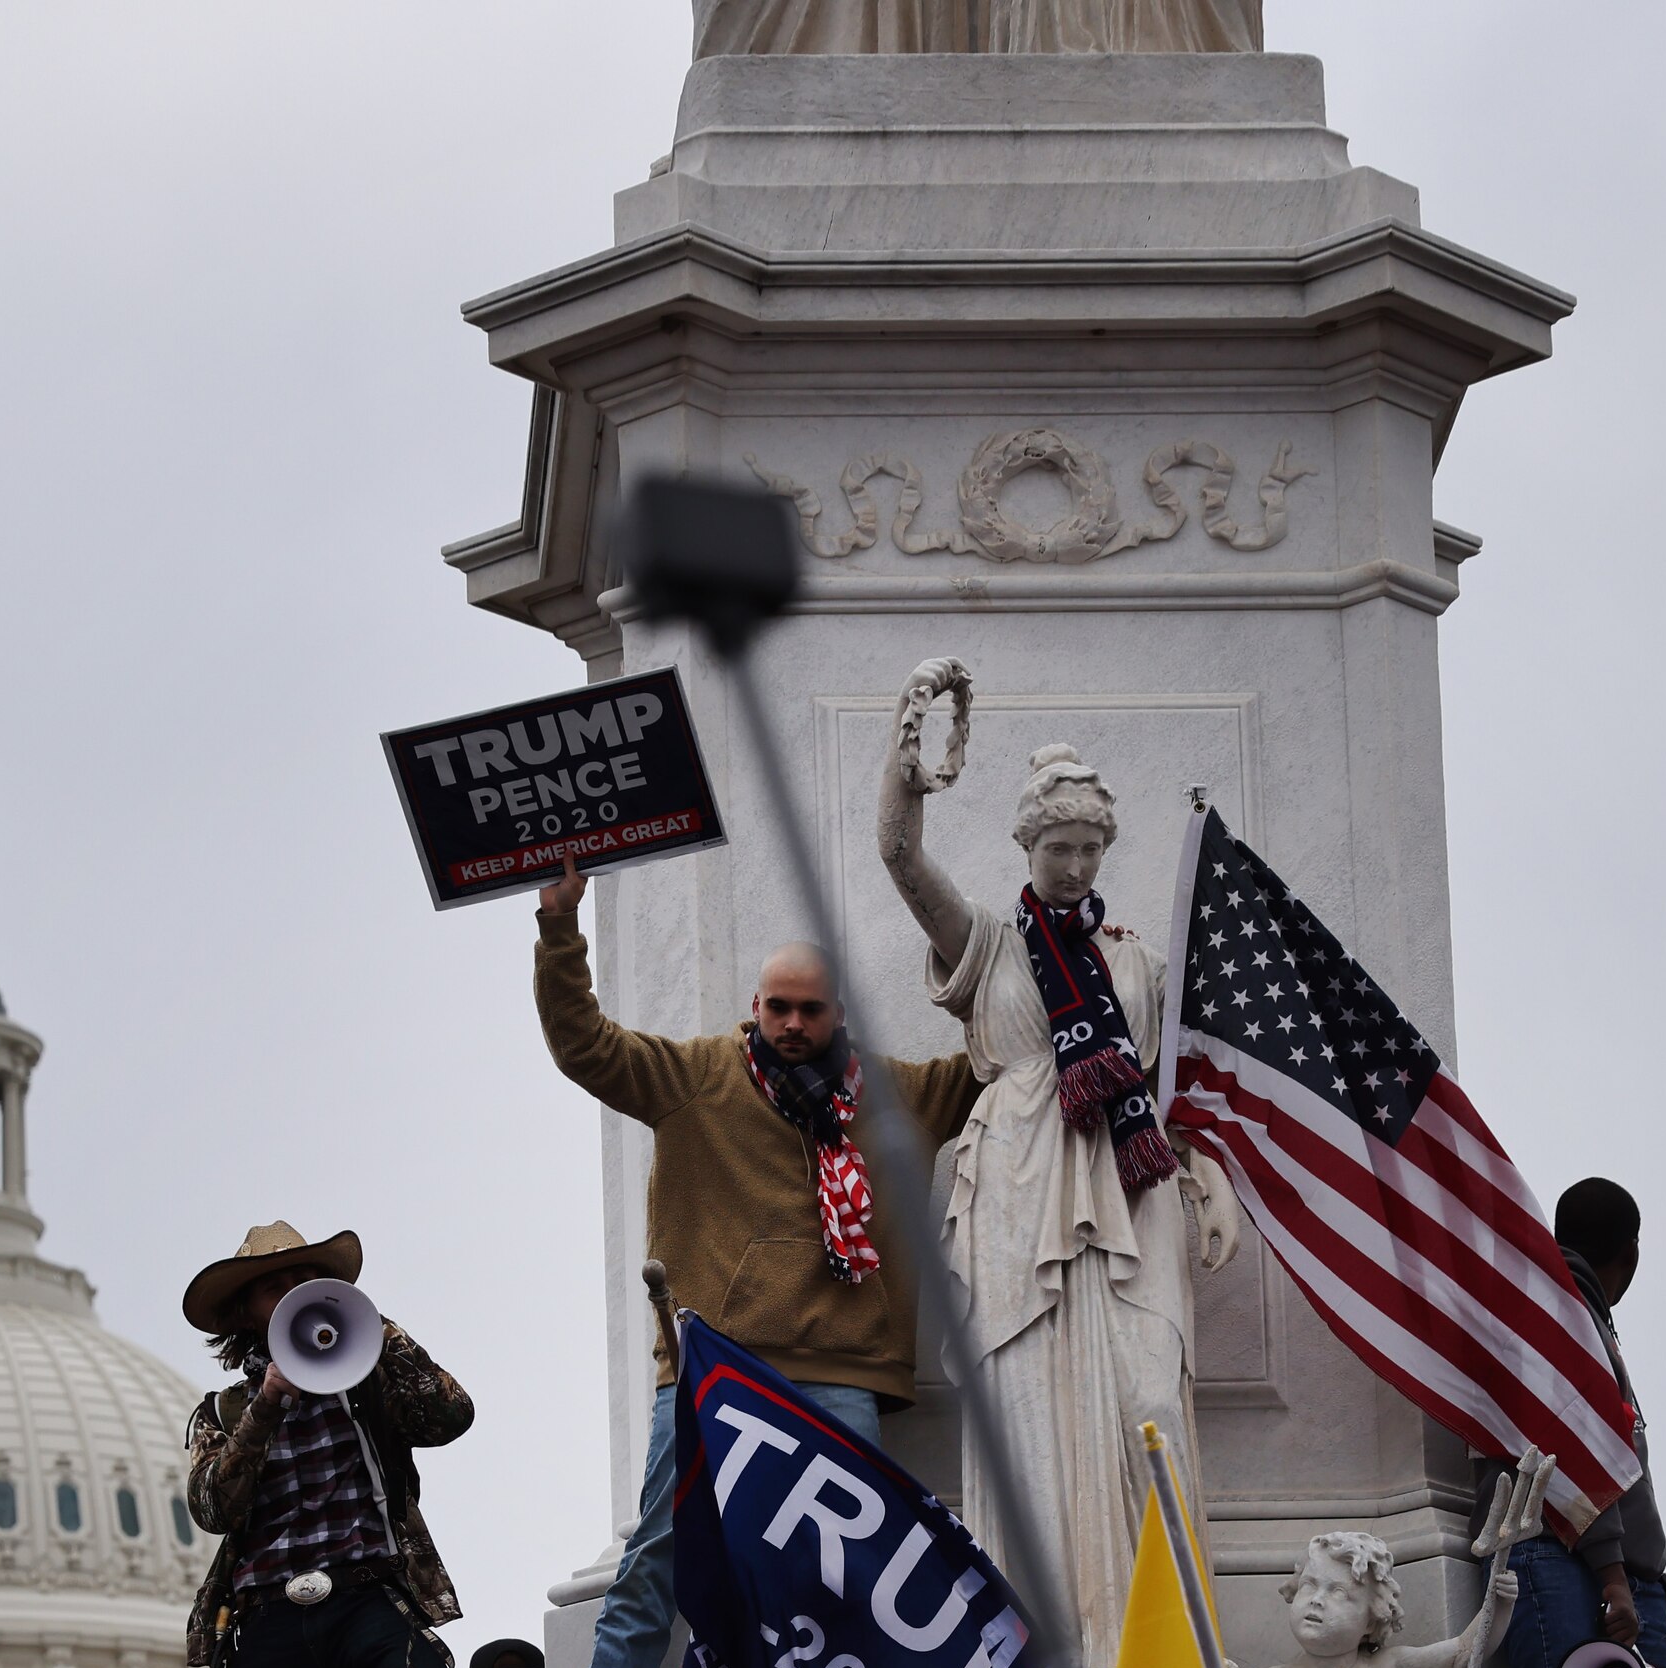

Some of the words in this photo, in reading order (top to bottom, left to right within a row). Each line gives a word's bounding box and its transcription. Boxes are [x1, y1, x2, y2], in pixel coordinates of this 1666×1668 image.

[413, 692, 664, 787] TRUMP
[467, 751, 648, 825] PENCE
[515, 800, 620, 843] 2020
[460, 856, 516, 881] KEEP
[522, 831, 619, 868] AMERICA
[621, 814, 691, 844] GREAT
[1114, 1094, 1155, 1129] 20
